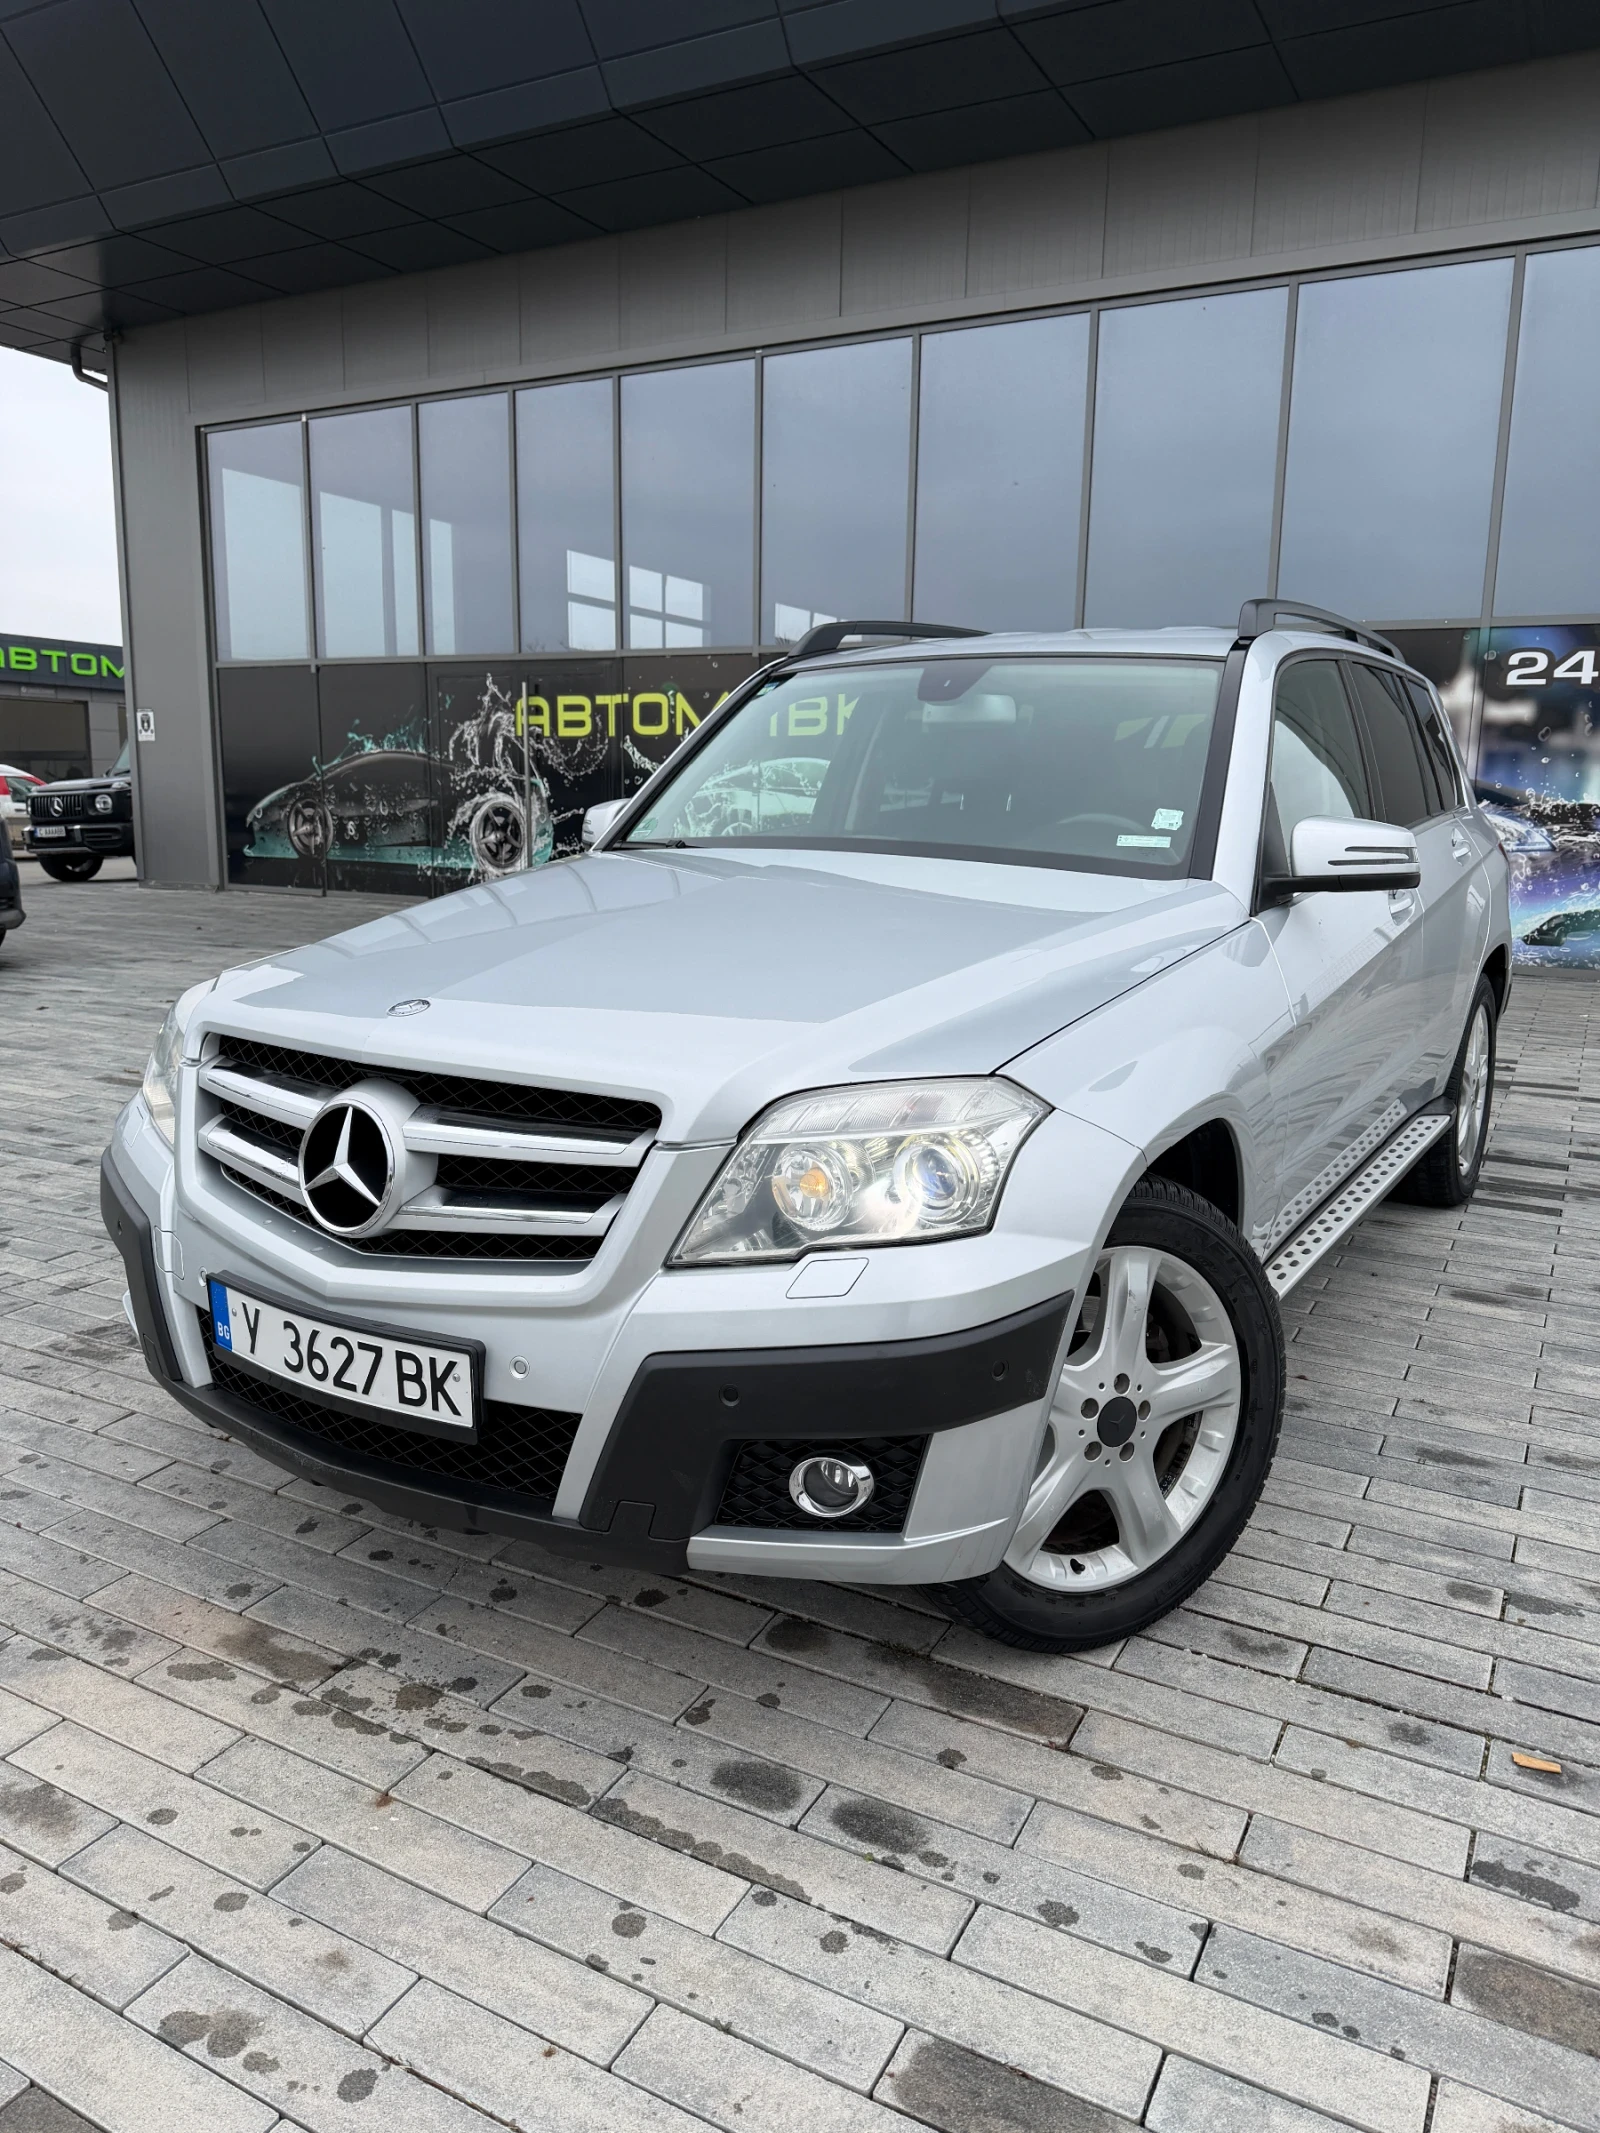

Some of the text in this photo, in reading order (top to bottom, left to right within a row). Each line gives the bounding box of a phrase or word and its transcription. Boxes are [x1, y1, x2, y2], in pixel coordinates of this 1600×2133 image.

[0, 646, 124, 678] ВТОМ
[1506, 650, 1599, 685] 24
[217, 1321, 231, 1340] BG
[283, 1320, 383, 1396] 3627
[395, 1350, 462, 1417] BK
